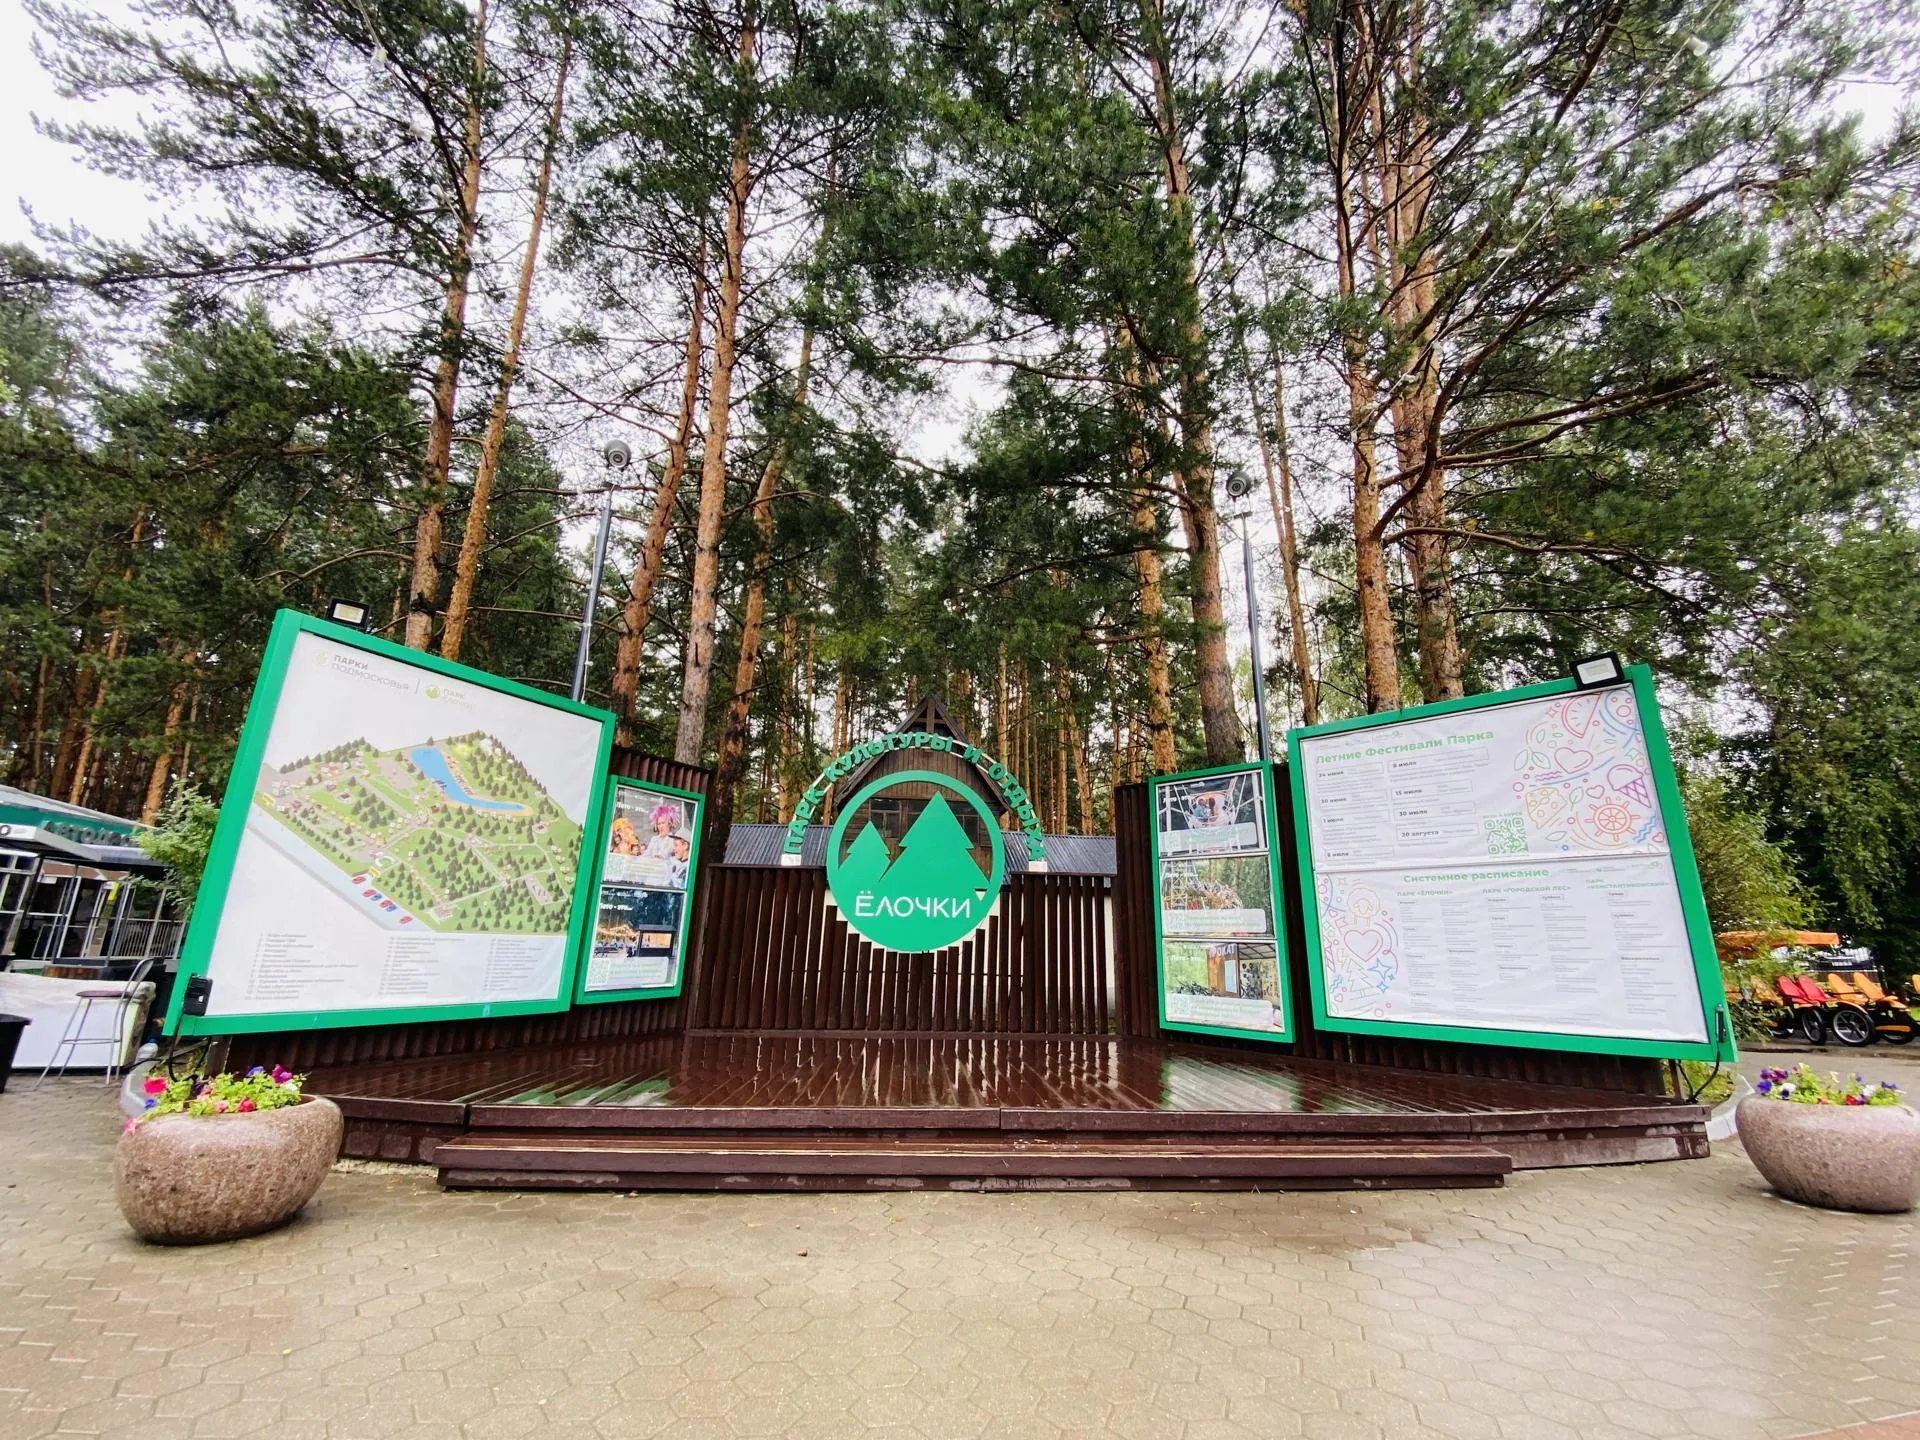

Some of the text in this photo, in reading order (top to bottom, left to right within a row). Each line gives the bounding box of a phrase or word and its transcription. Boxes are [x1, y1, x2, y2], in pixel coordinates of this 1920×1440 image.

[333, 654, 369, 670] ПАРКИ
[1316, 751, 1362, 765] Летние
[1365, 738, 1443, 757] Фестивали
[1447, 730, 1495, 745] Парка
[783, 730, 1046, 862] ПАРК КУЛЬТУРЫ И ОТДЫХА
[1403, 867, 1550, 884] Системное расписание
[854, 889, 971, 919] ЁЛОЧКИ
